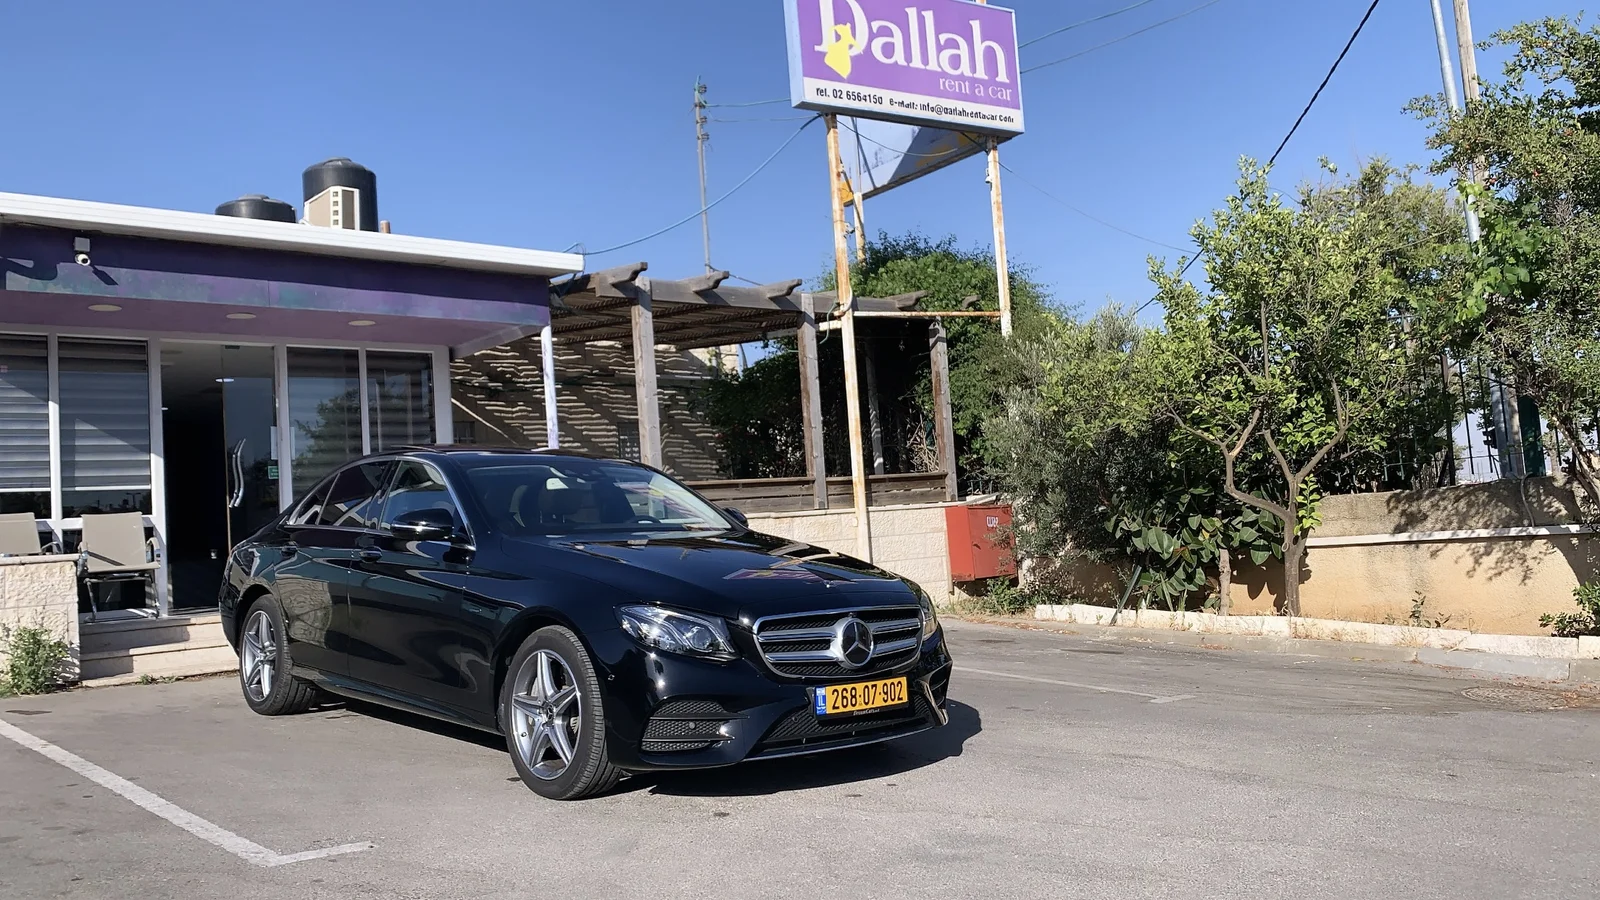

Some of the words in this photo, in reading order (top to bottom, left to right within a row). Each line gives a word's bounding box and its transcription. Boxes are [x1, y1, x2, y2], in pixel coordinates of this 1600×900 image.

[814, 0, 1010, 83] Dallah
[832, 88, 843, 99] 02
[939, 76, 969, 96] rent
[975, 81, 984, 97] a
[988, 85, 1012, 101] car
